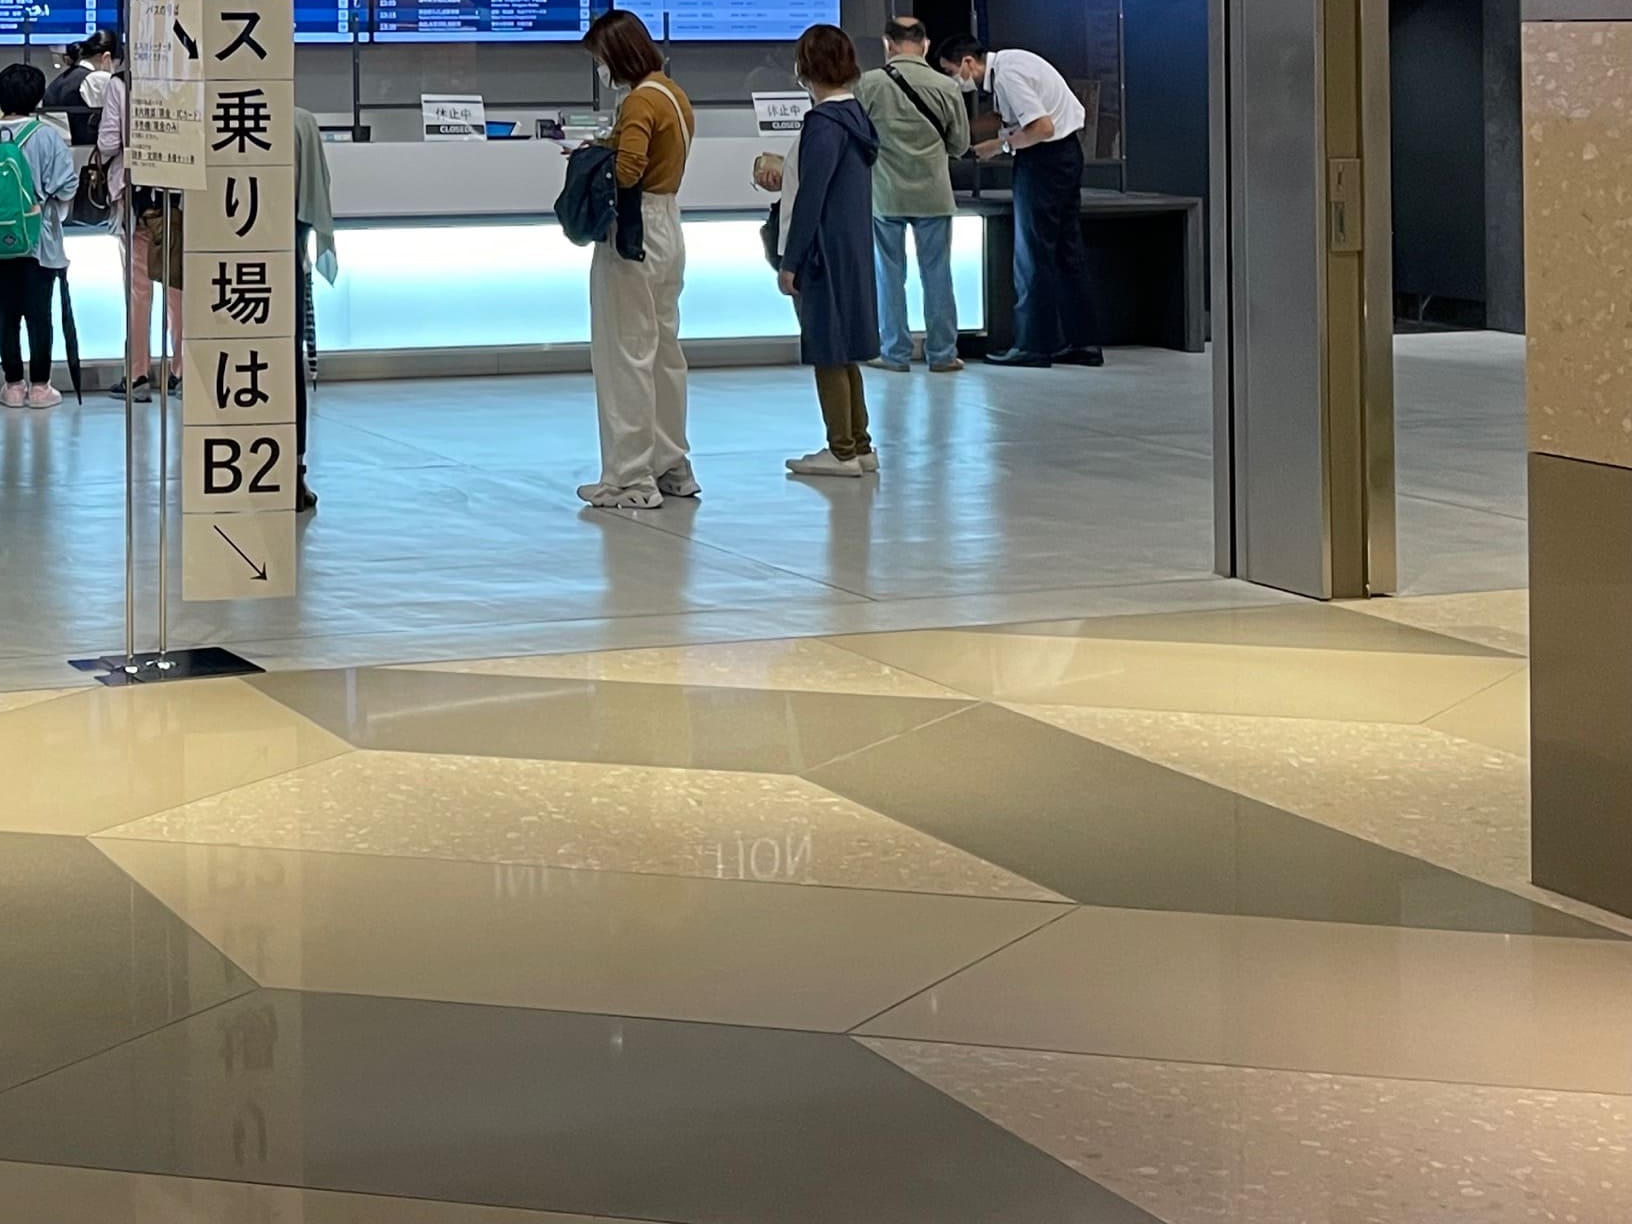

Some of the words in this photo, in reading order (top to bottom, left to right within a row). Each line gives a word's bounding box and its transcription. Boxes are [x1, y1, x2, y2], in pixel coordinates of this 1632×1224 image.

[436, 107, 472, 121] 休止中
[768, 104, 801, 117] 休止中
[440, 125, 473, 134] CLOSED
[772, 121, 801, 129] CLOSED
